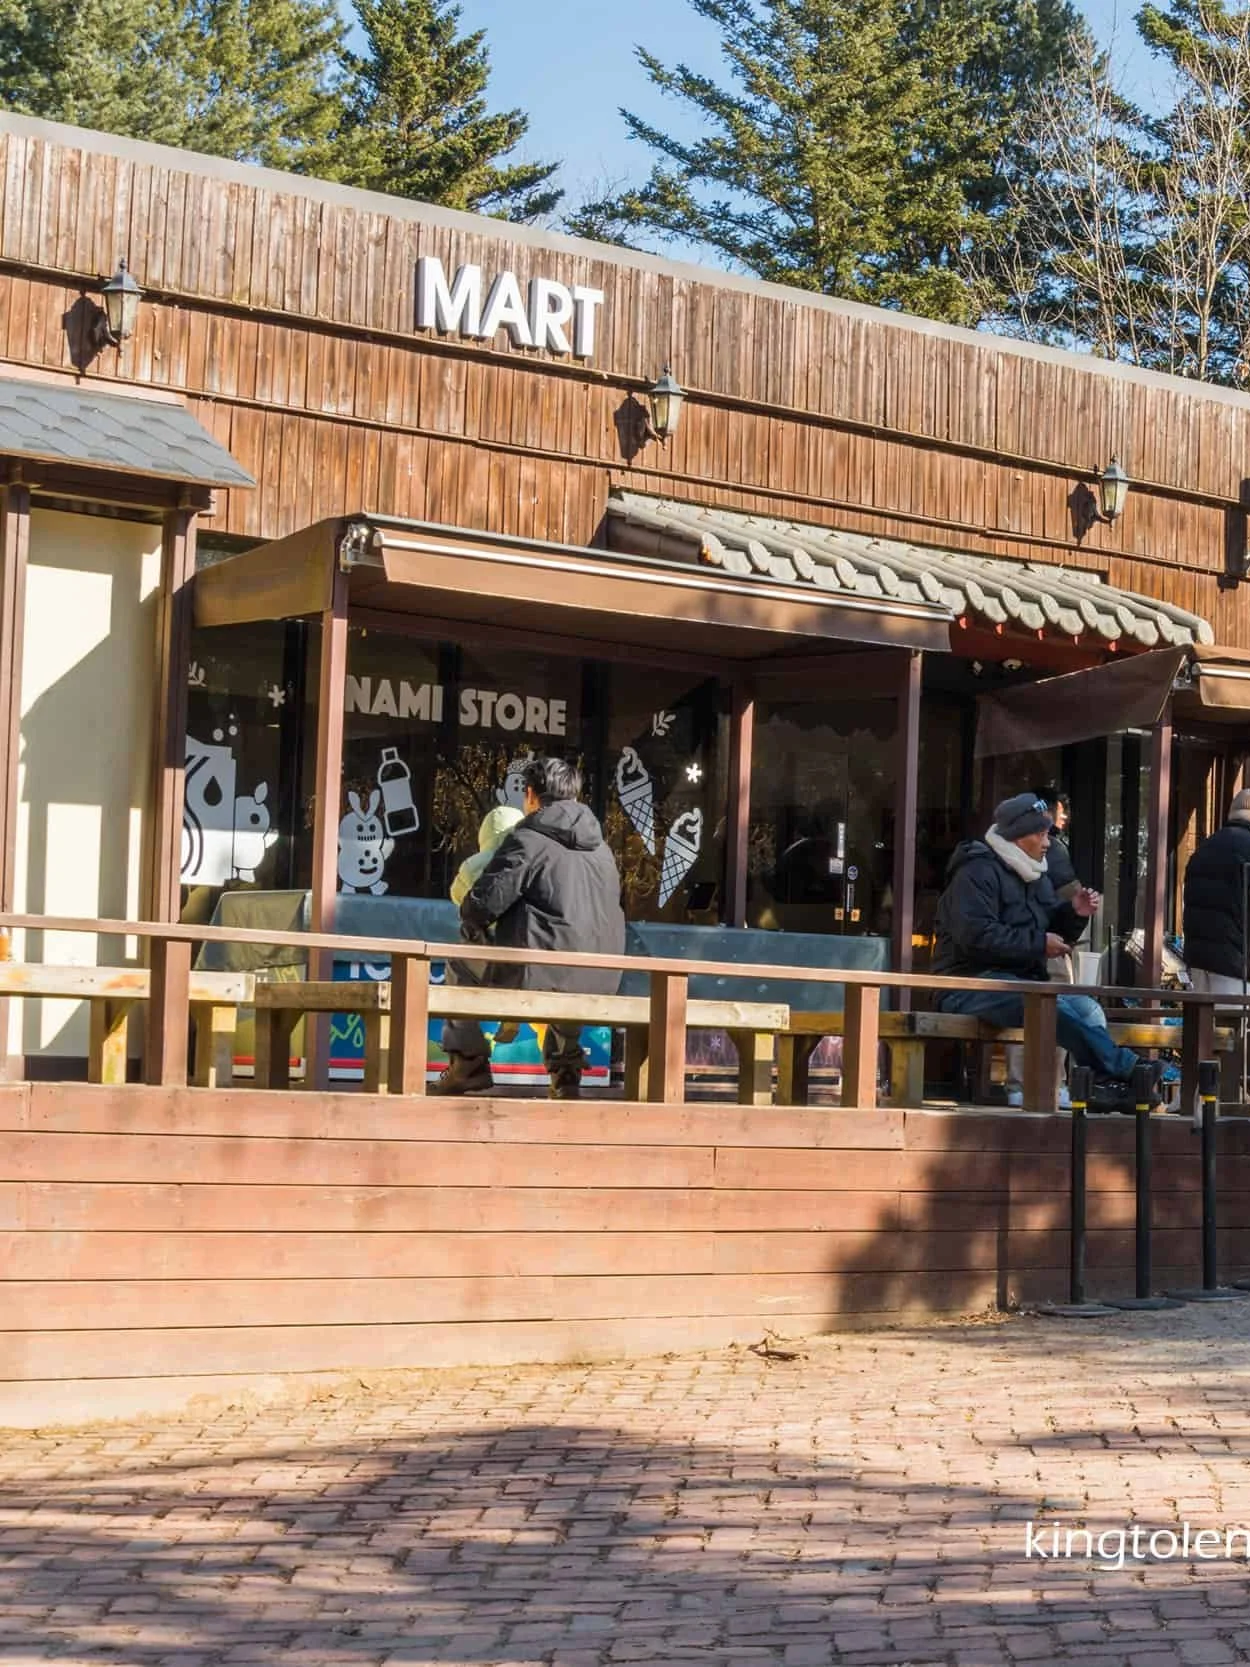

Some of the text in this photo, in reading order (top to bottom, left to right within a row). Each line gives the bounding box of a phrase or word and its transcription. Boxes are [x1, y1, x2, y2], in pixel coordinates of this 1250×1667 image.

[418, 256, 604, 357] MART
[345, 674, 567, 736] NAMI STORE
